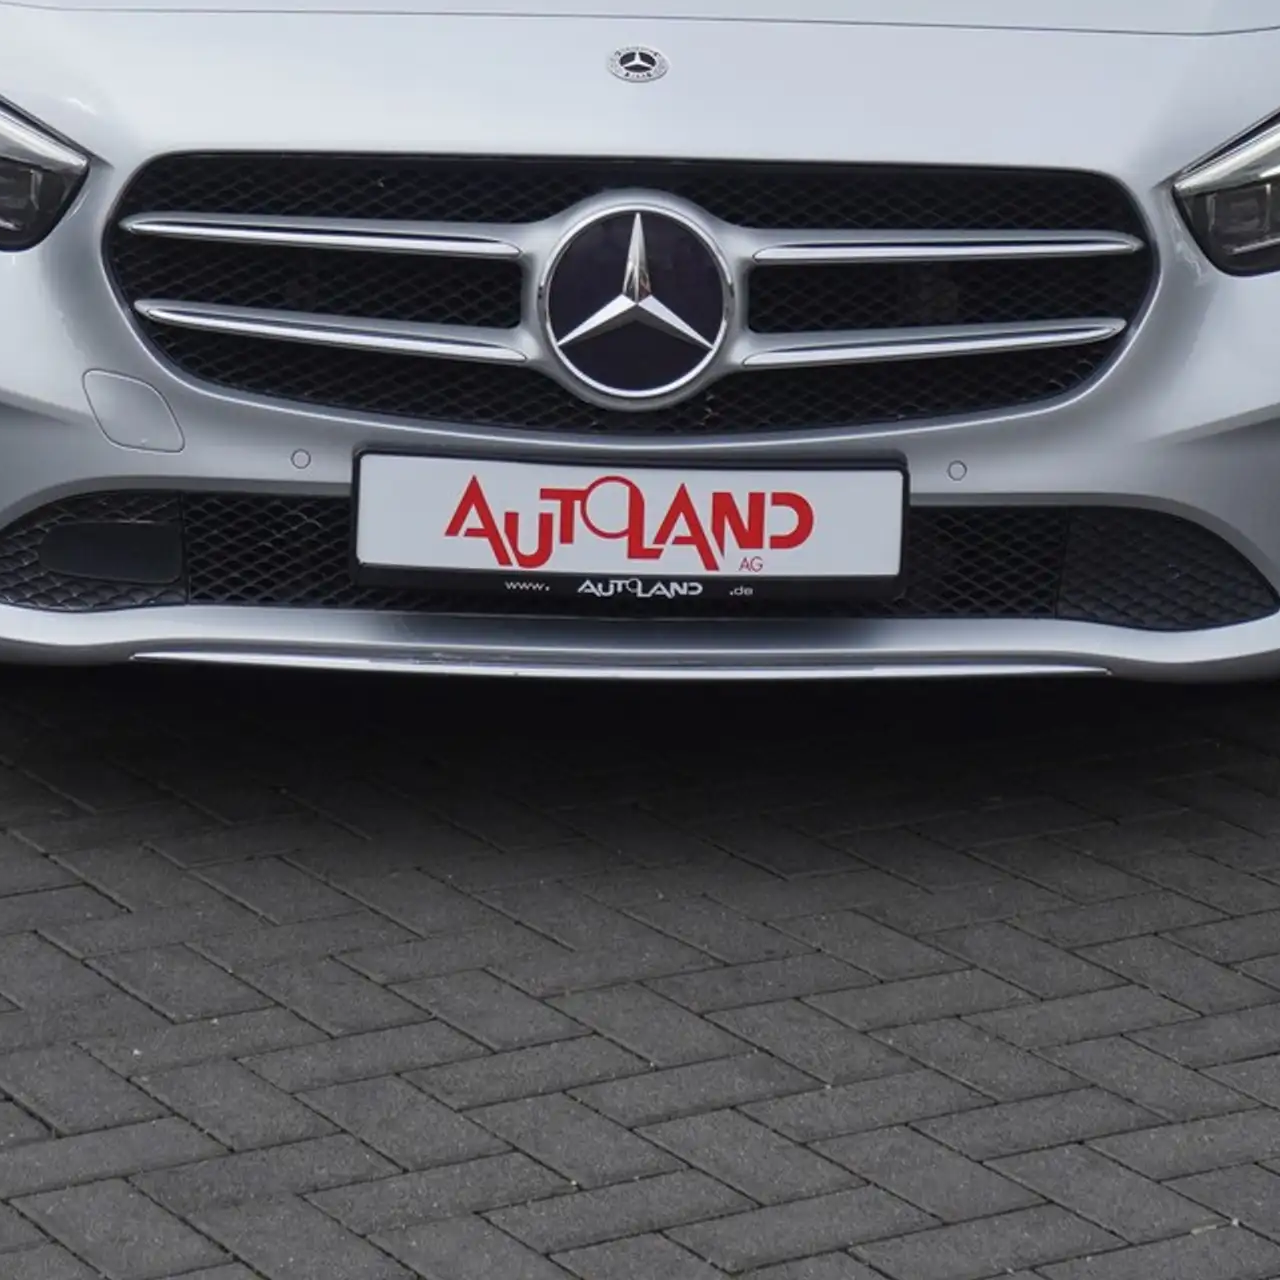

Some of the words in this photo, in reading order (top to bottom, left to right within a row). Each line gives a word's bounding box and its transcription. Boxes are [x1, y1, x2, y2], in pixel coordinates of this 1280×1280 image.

[444, 474, 814, 571] AUTOLAND
[738, 556, 763, 572] AG
[504, 580, 550, 592] www.
[577, 577, 704, 599] AUTOLAND
[729, 584, 754, 597] .de
